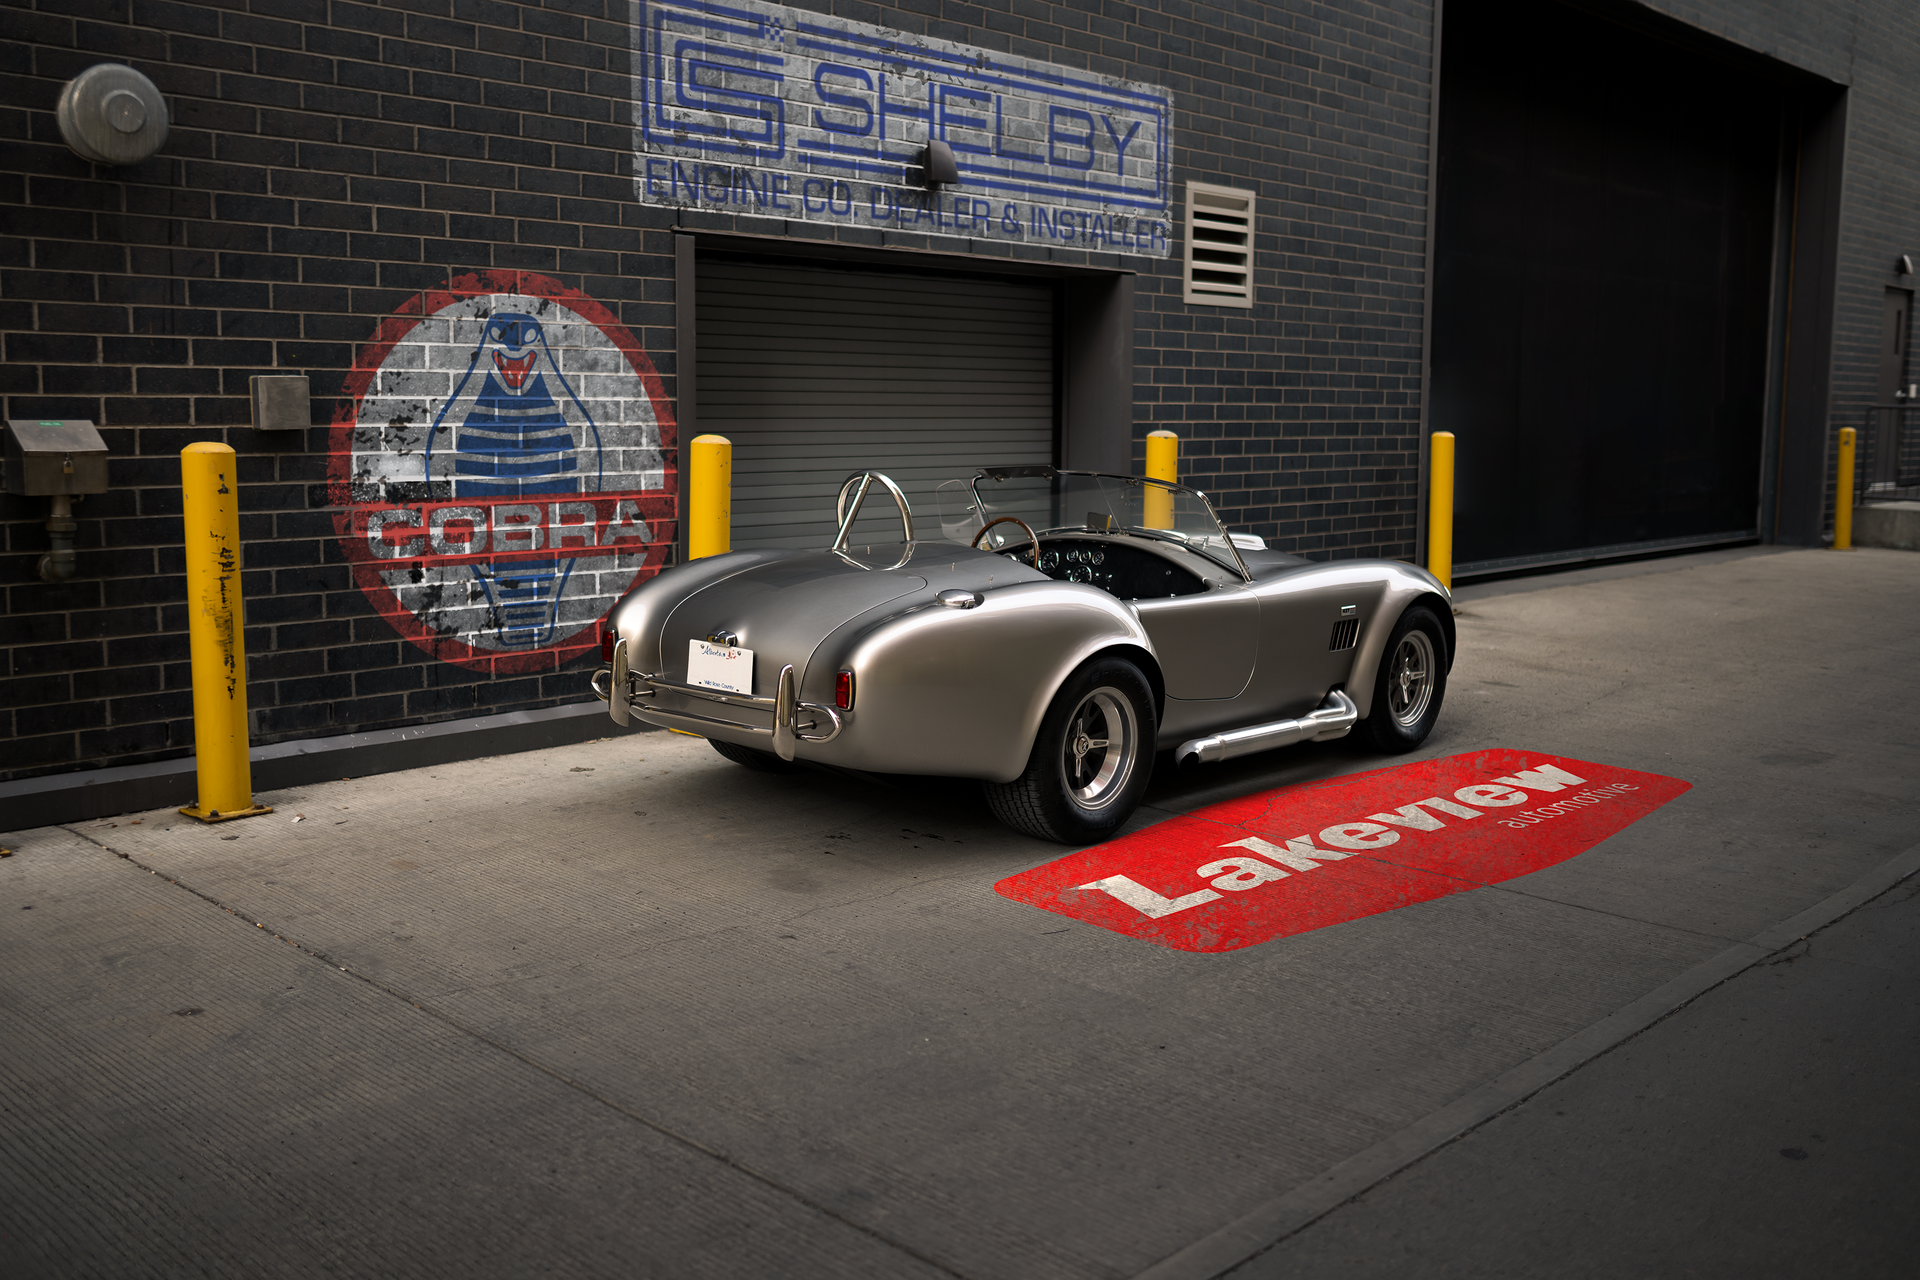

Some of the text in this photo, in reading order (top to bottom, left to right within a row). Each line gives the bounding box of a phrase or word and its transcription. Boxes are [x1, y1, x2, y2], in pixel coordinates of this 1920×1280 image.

[814, 62, 1142, 176] SHELBY
[646, 158, 1166, 250] ENGINE CO. DEALER & INSTALLER
[367, 500, 655, 559] COBRA
[1069, 763, 1588, 919] Lakeview
[1497, 783, 1640, 829] automotive
